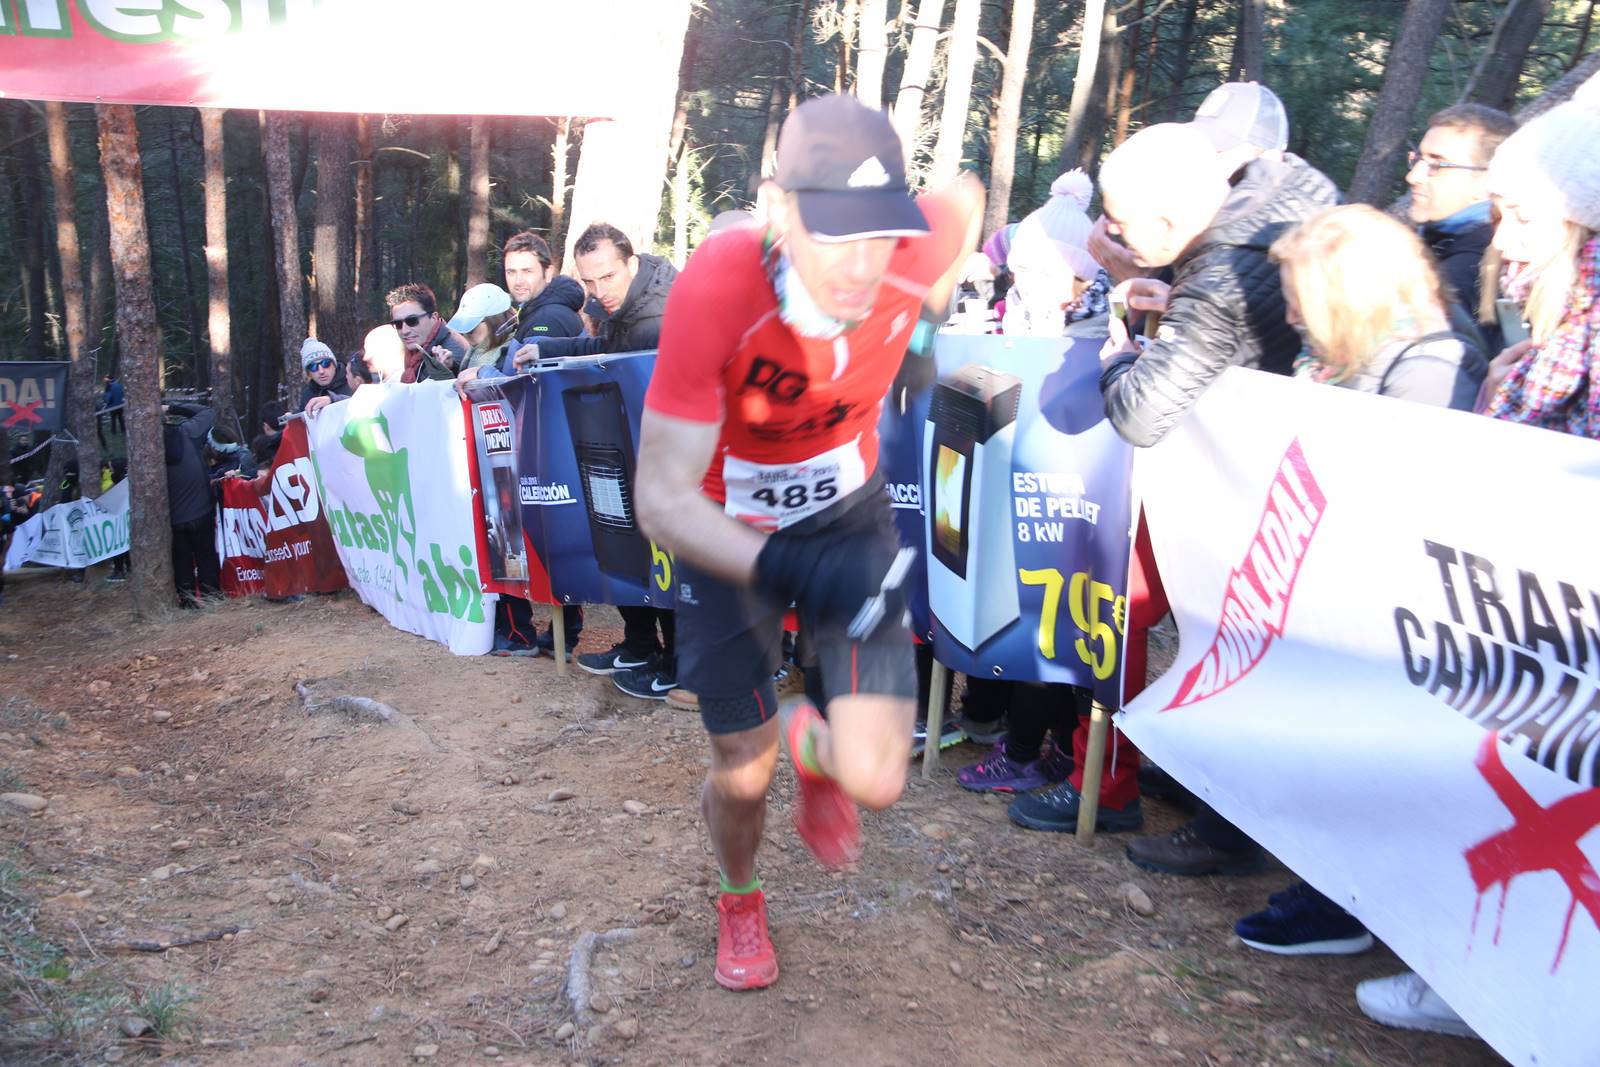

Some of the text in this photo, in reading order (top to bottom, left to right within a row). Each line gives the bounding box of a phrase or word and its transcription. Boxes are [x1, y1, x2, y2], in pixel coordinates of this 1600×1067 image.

[0, 377, 56, 409] DA!
[752, 477, 838, 509] 485
[1014, 497, 1042, 518] DE
[1018, 522, 1064, 543] 8 kW
